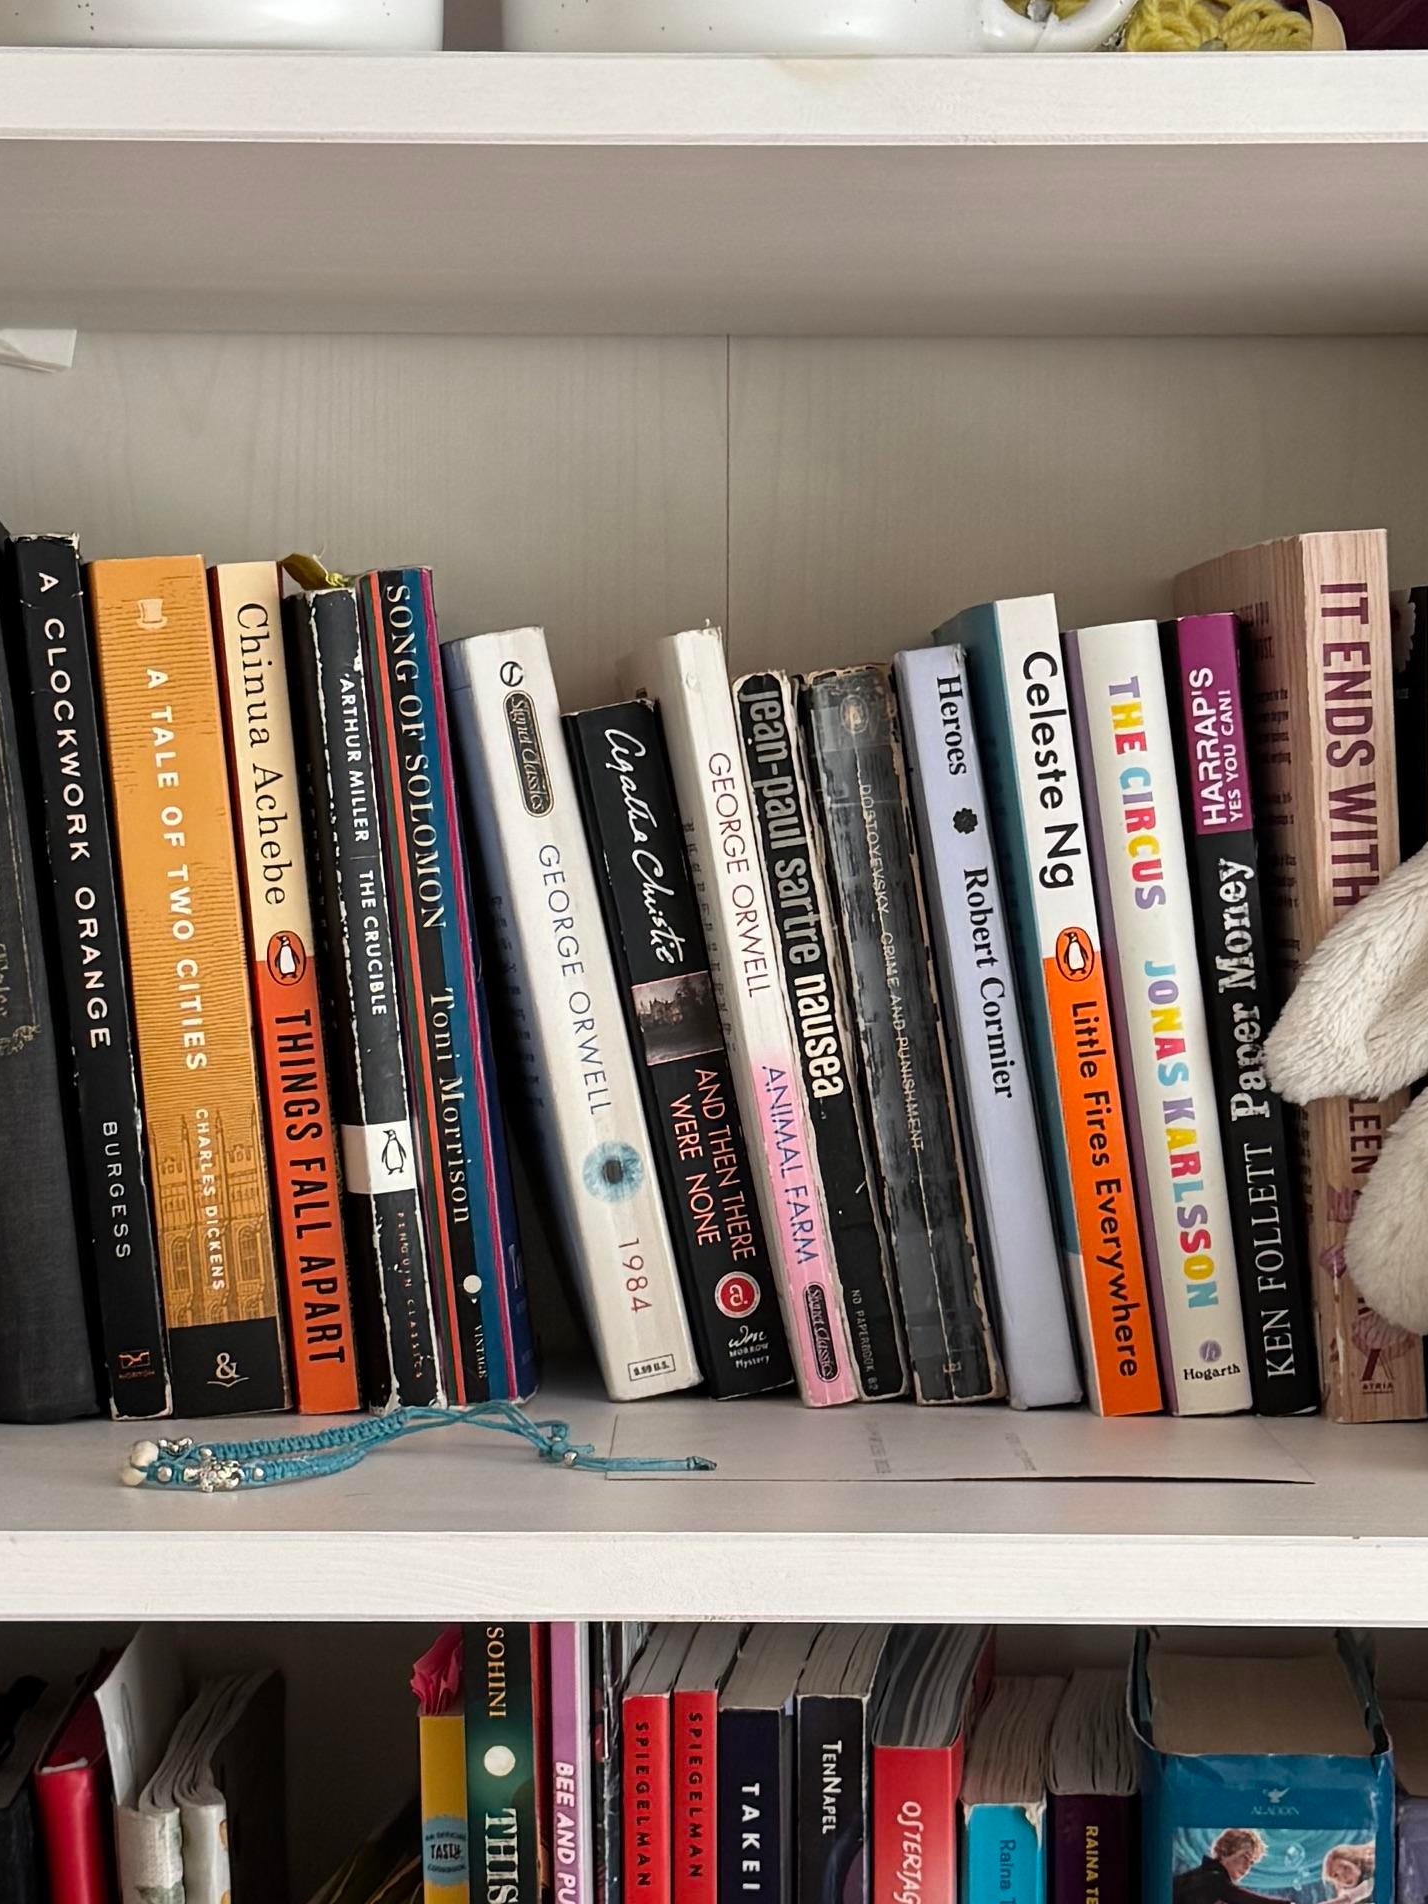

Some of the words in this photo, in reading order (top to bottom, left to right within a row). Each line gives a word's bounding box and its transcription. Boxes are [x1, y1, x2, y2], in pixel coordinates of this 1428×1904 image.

[39, 572, 59, 594] A
[385, 584, 420, 682] SONG
[1319, 582, 1369, 626] IT
[146, 669, 168, 689] A
[237, 601, 271, 750] Chinua
[394, 692, 425, 740] OF
[1108, 676, 1145, 756] THE
[1322, 643, 1376, 768] ENDS
[43, 617, 93, 863] CLOCKWORK
[149, 705, 179, 791] TALE
[1021, 652, 1070, 810] Celeste
[1189, 668, 1228, 826] HARRAP'S
[161, 804, 186, 850] OF
[251, 763, 286, 906] Achebe
[404, 753, 446, 930] SOLOMON
[1043, 823, 1084, 890] Ng
[1118, 769, 1167, 911] CIRCUS
[167, 863, 195, 940] TWO
[358, 870, 379, 919] THE
[73, 888, 111, 1051] ORANGE
[176, 947, 207, 1071] CITIES
[360, 917, 388, 1017] CRUCIBLE
[538, 843, 584, 979] GEORGE
[567, 987, 615, 1116] ORWELL
[431, 988, 456, 1055] Toni
[794, 972, 845, 1098] nausea
[1071, 1001, 1097, 1080] Little
[1145, 960, 1190, 1087] JONAS
[274, 1008, 317, 1140] THINGS
[695, 1069, 726, 1119] AND
[434, 1065, 471, 1224] Morrison
[670, 1094, 703, 1161] WERE
[708, 1125, 741, 1187] THEN
[1084, 1092, 1113, 1168] Fires
[102, 1122, 131, 1261] BURGESS
[289, 1158, 329, 1238] FALL
[685, 1173, 721, 1245] NONE
[722, 1191, 756, 1261] THERE
[1162, 1097, 1220, 1310] KARLSSON
[301, 1259, 345, 1366] APART
[618, 1237, 653, 1315] 1984
[1094, 1179, 1138, 1378] Everywhere
[1182, 1363, 1242, 1382] Hogarth
[634, 1721, 650, 1888] SPIEGELMAN
[687, 1711, 704, 1880] SPIEGELMAN
[741, 1783, 761, 1892] TAKEI
